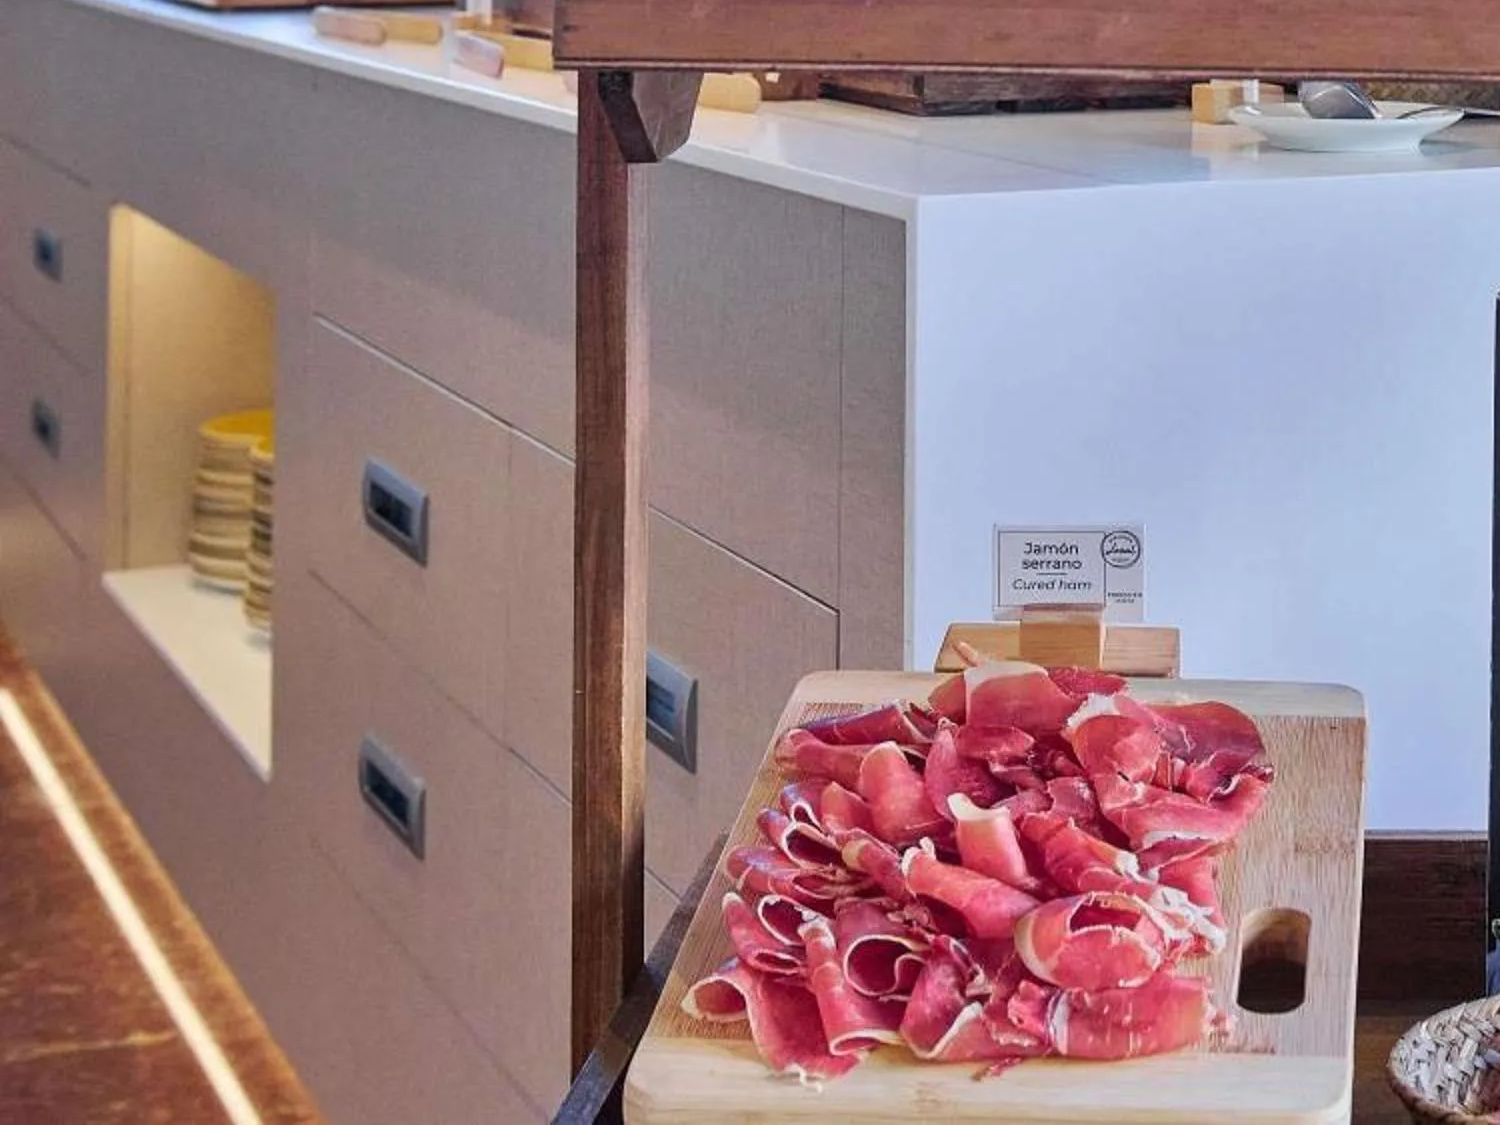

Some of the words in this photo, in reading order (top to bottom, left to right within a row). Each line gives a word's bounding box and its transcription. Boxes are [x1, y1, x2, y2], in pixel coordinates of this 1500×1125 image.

[1024, 542, 1079, 554] Jamón
[1022, 559, 1082, 570] serrano
[1012, 579, 1055, 590] Cured
[1058, 579, 1092, 590] ham
